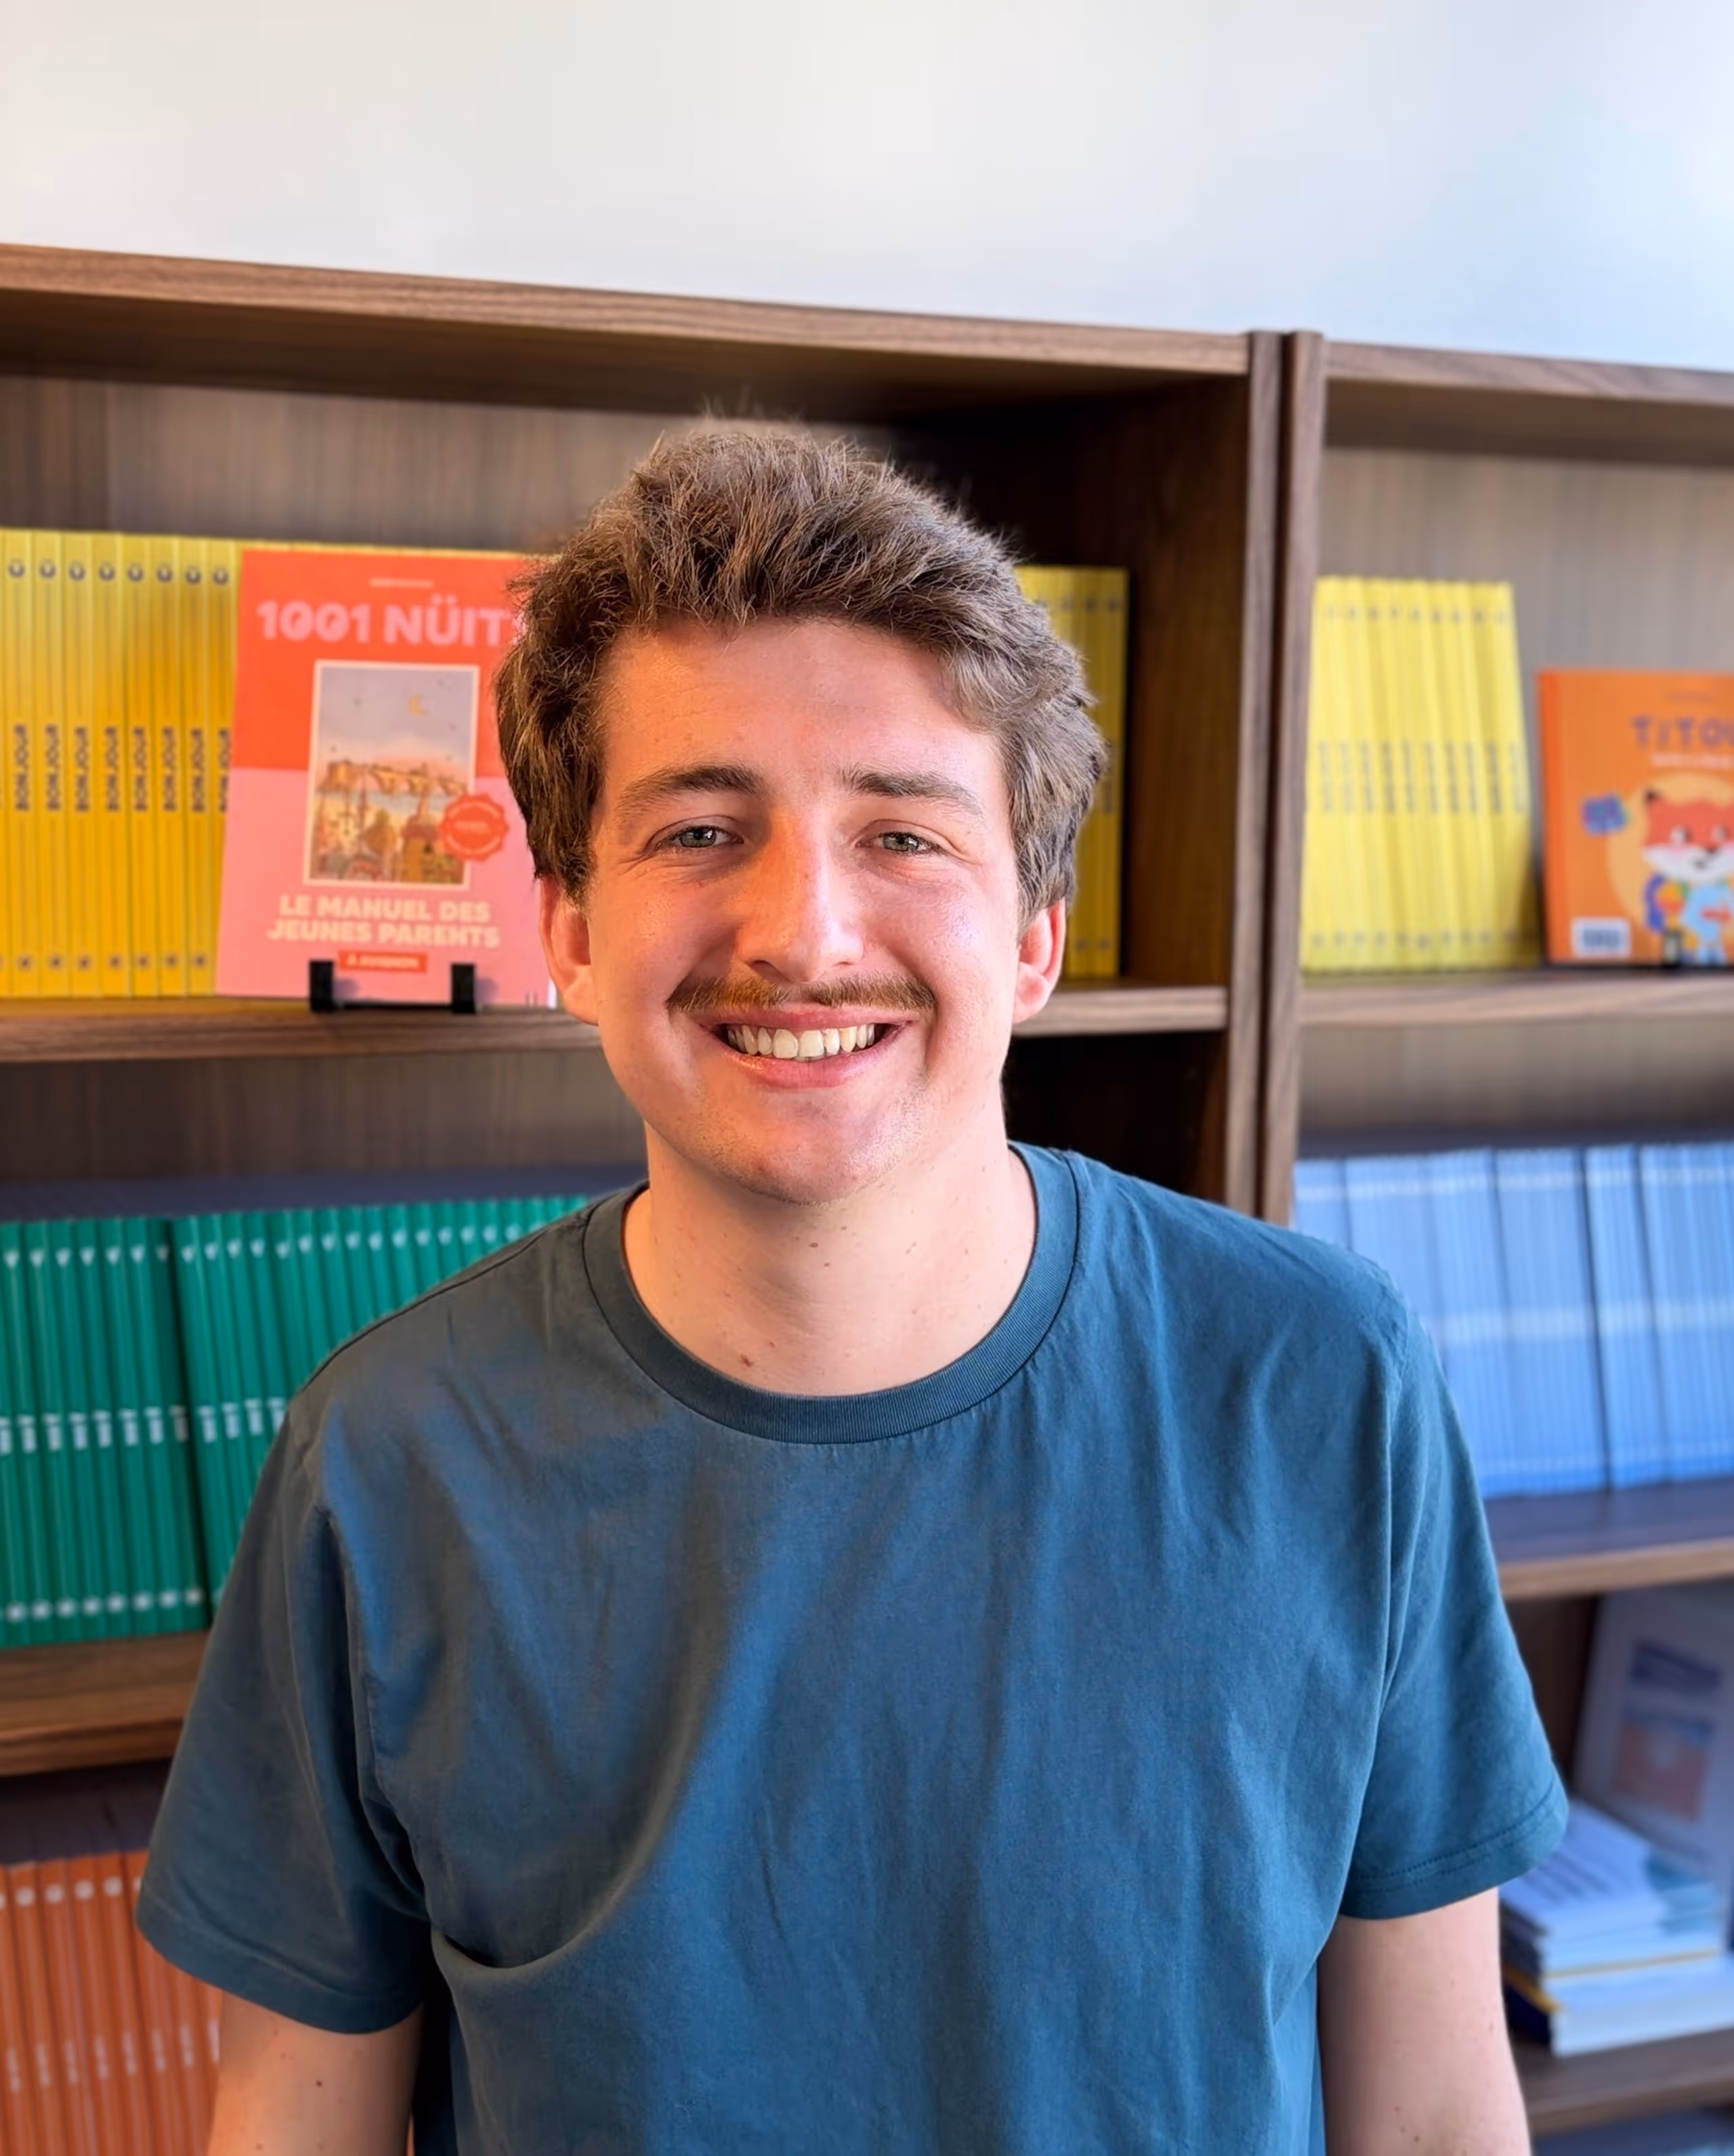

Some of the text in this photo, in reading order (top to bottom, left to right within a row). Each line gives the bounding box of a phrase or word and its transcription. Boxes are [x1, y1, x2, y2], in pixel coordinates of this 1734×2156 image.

[257, 600, 371, 643] 1001
[280, 894, 490, 923] LE MANUEL DES
[266, 918, 500, 948] JEUNES PARENTS
